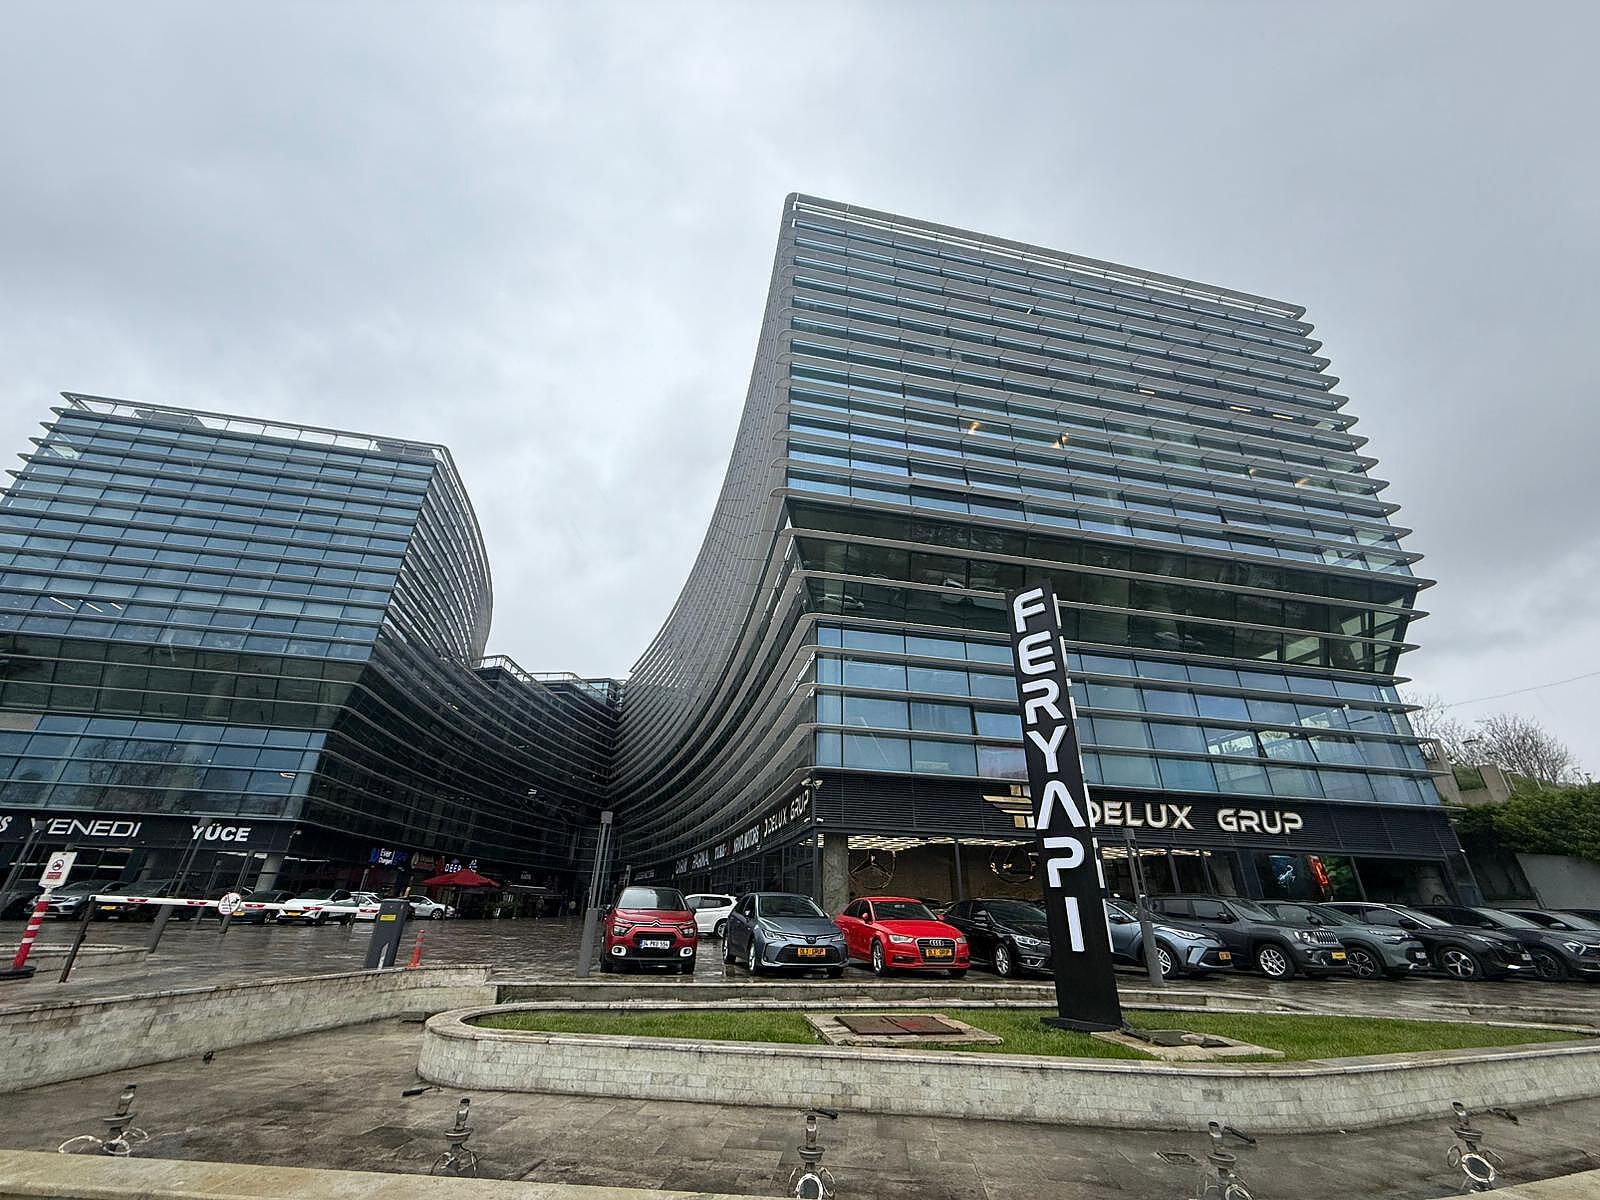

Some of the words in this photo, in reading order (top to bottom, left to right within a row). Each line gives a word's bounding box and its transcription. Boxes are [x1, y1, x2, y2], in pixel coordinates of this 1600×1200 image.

[1012, 587, 1085, 953] FERYAPI
[790, 789, 809, 820] GRUP
[192, 823, 252, 842] YÜCE
[1217, 807, 1304, 835] GRUP
